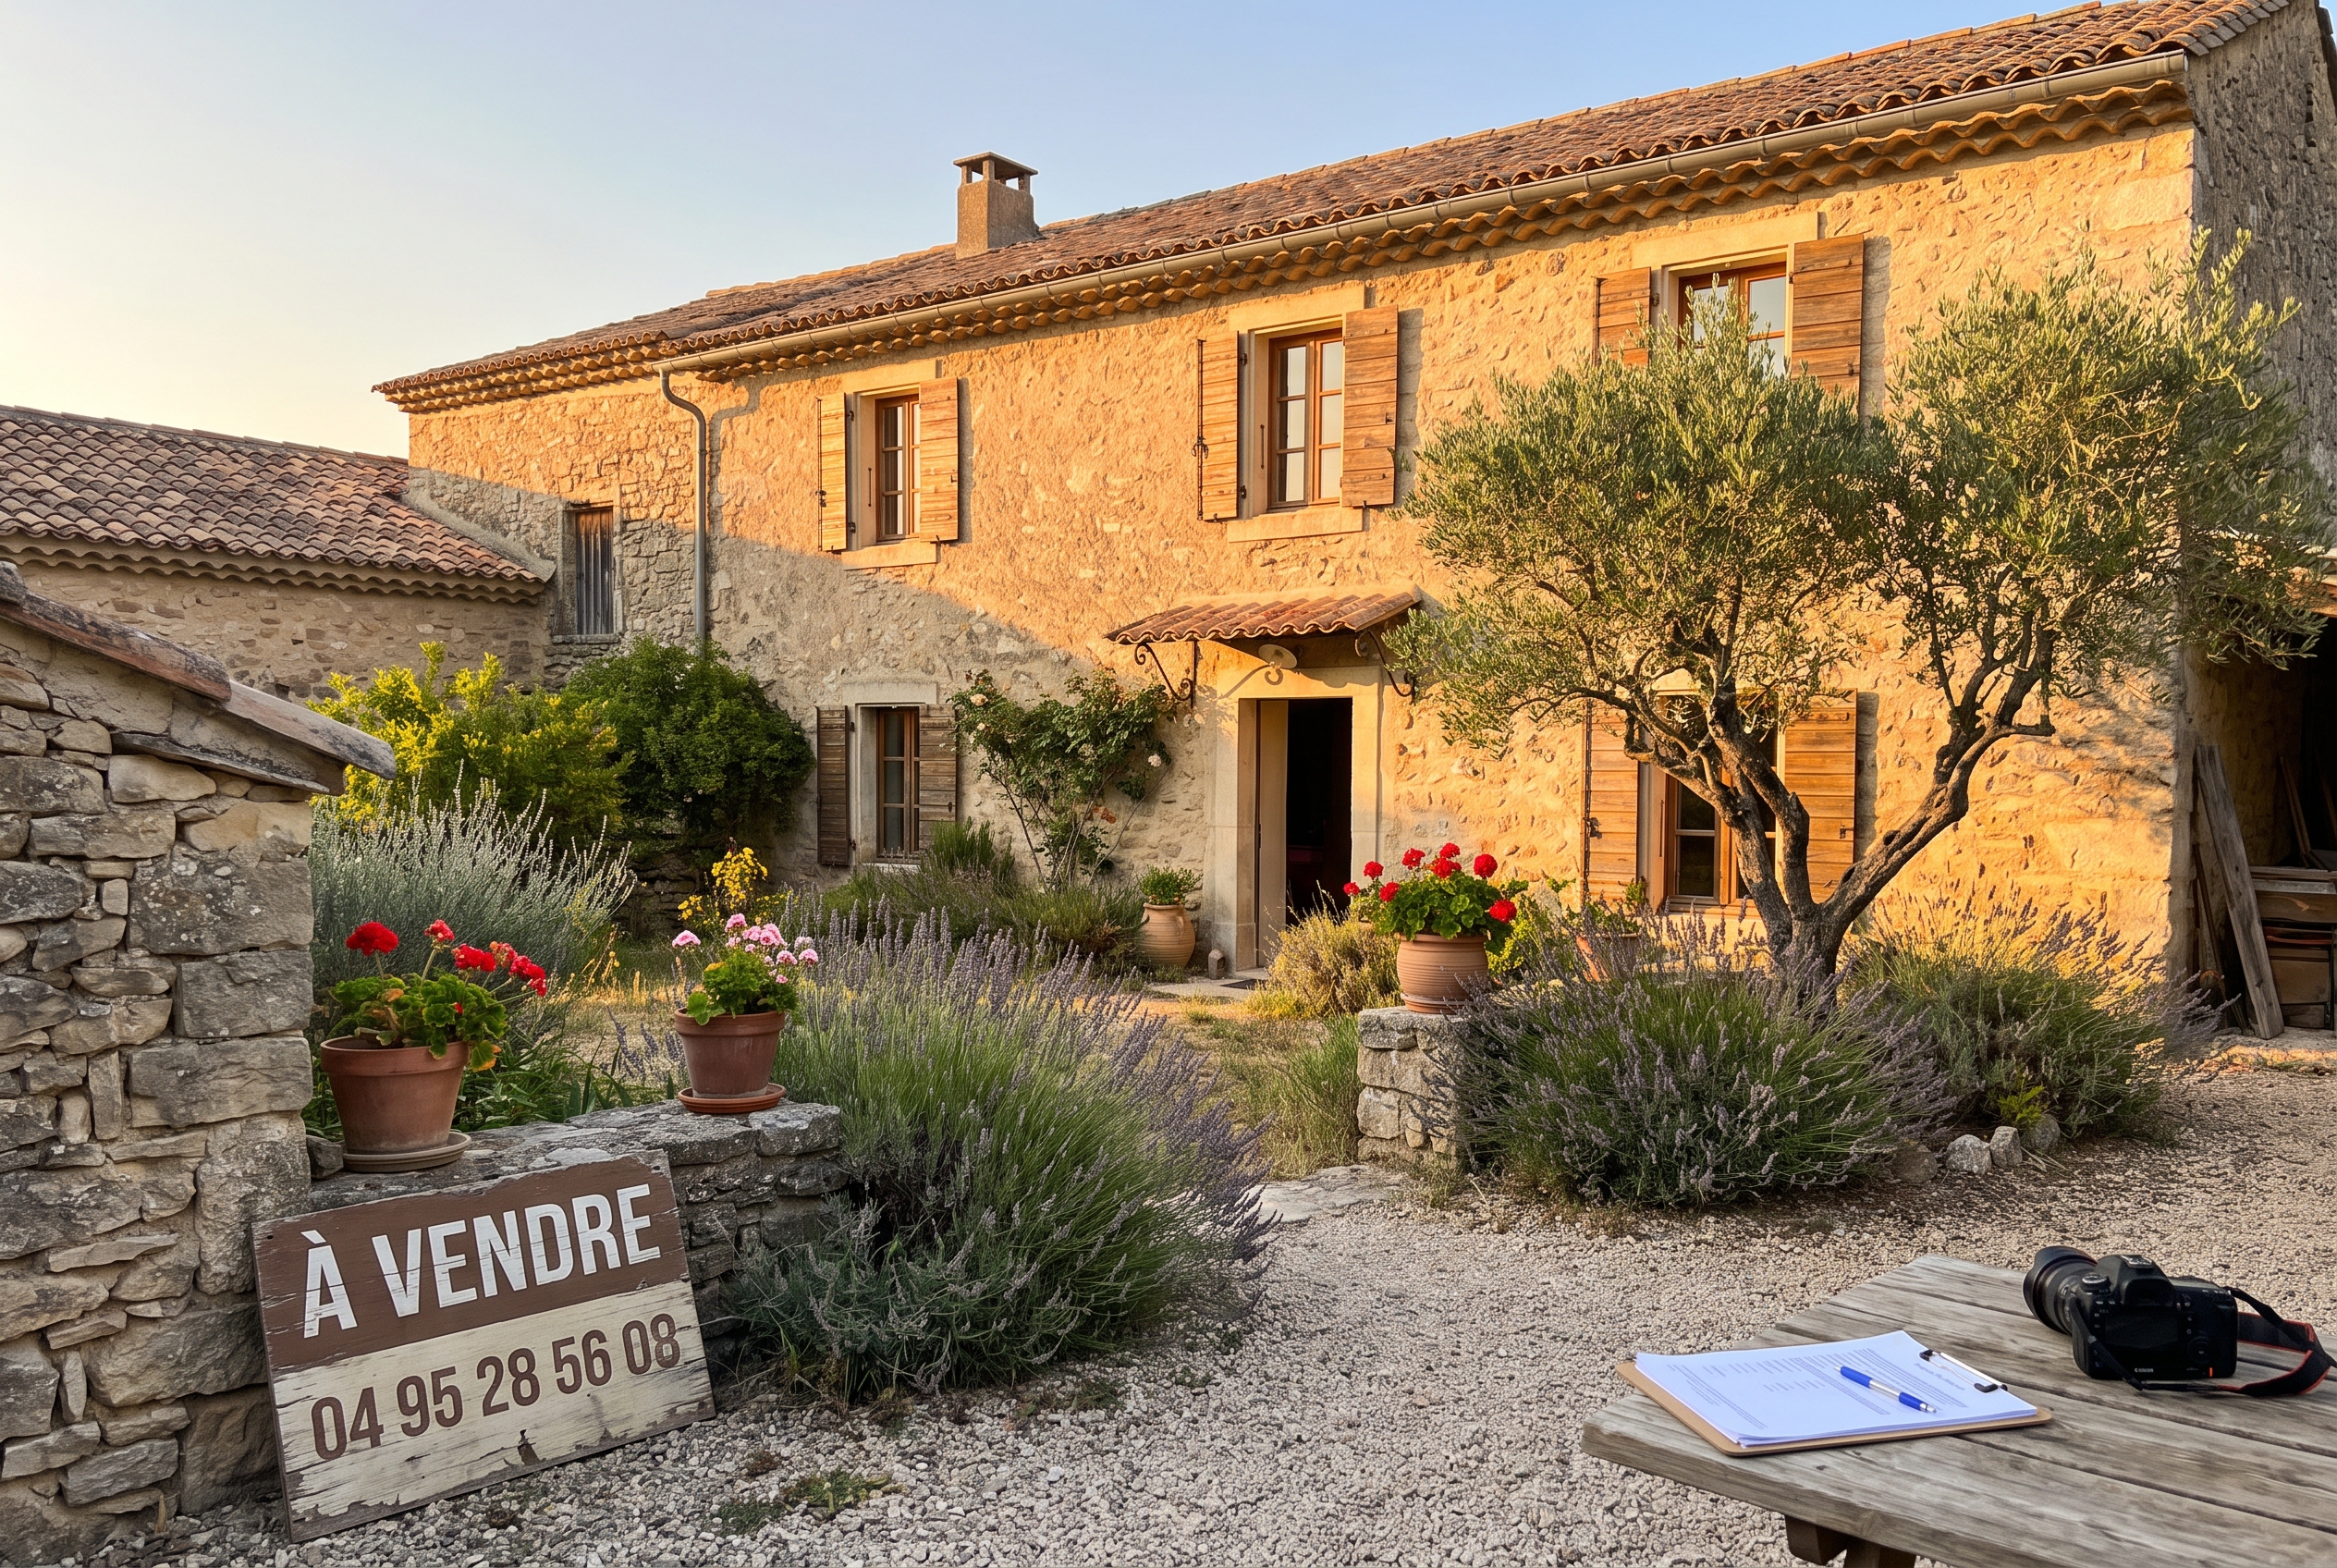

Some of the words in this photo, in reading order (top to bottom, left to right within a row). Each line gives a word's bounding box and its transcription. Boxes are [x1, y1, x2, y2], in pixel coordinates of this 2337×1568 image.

[300, 1230, 358, 1339] À
[372, 1183, 661, 1317] VENDRE
[311, 1387, 385, 1462] 04
[396, 1366, 463, 1438] 95
[476, 1347, 541, 1417] 28
[551, 1329, 612, 1396] 56
[621, 1313, 681, 1376] 08
